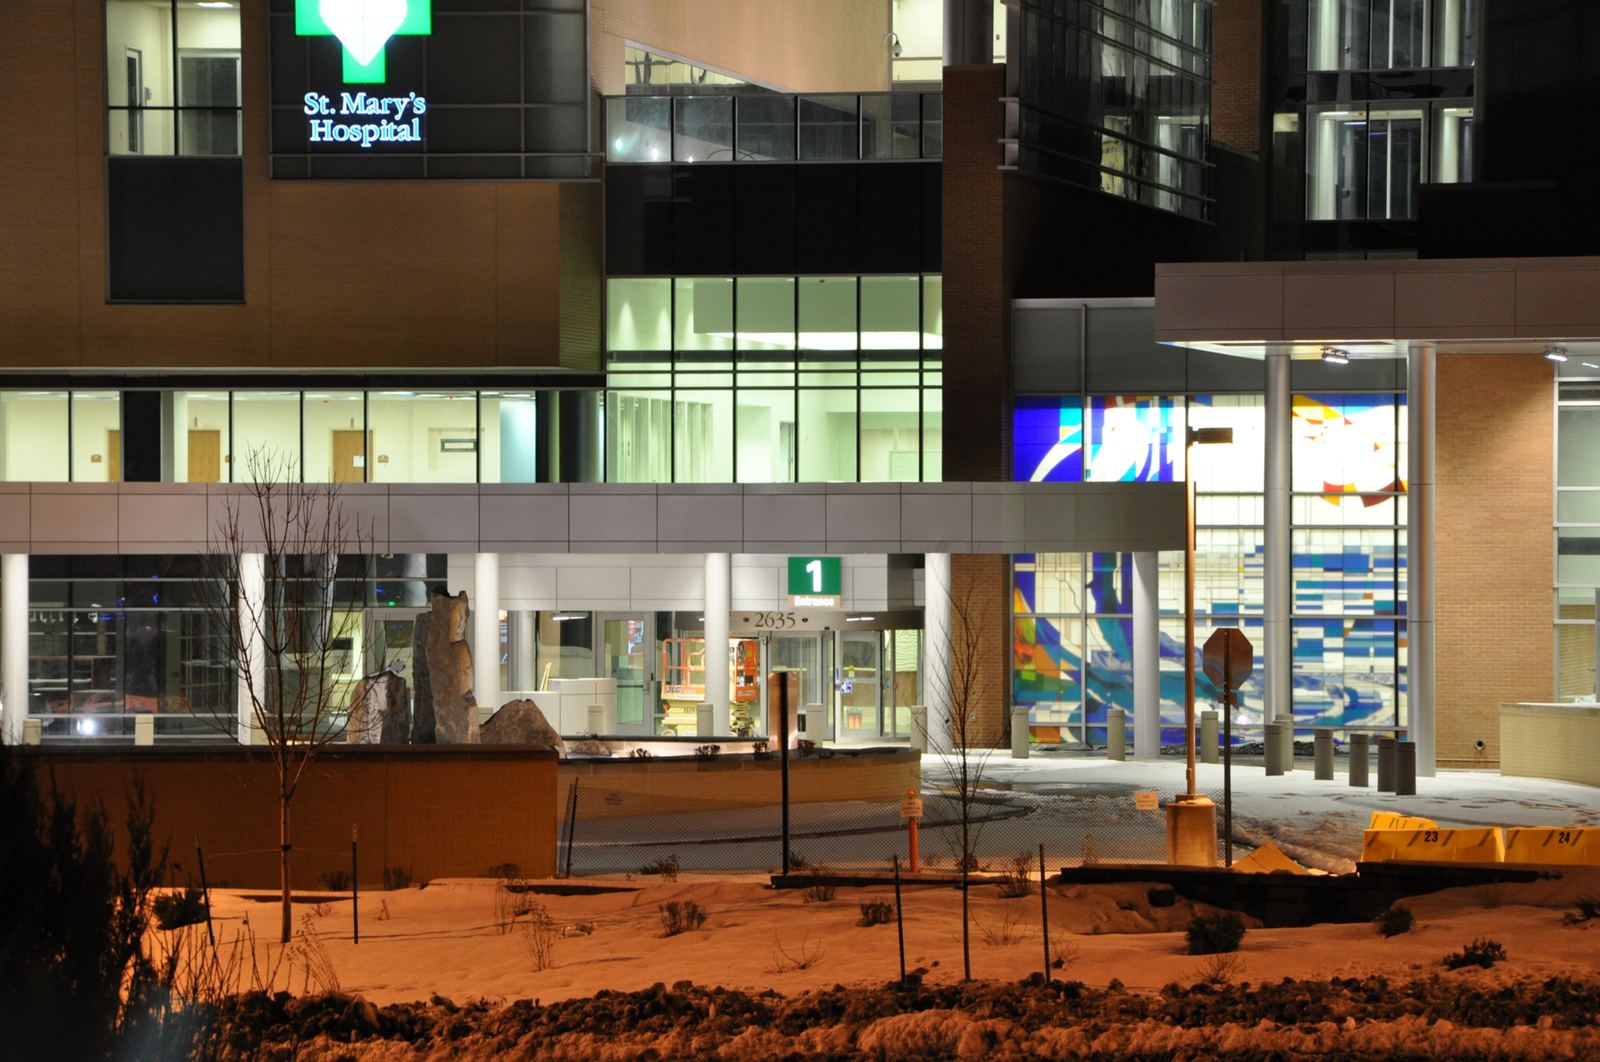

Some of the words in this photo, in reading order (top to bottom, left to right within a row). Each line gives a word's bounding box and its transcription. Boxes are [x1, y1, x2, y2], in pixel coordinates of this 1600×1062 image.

[304, 92, 336, 115] St.
[340, 92, 426, 120] Mary's
[309, 117, 421, 147] Hospital
[806, 560, 822, 592] 1
[754, 611, 796, 629] 2635
[1424, 831, 1438, 842] 23
[1558, 832, 1570, 844] 24
